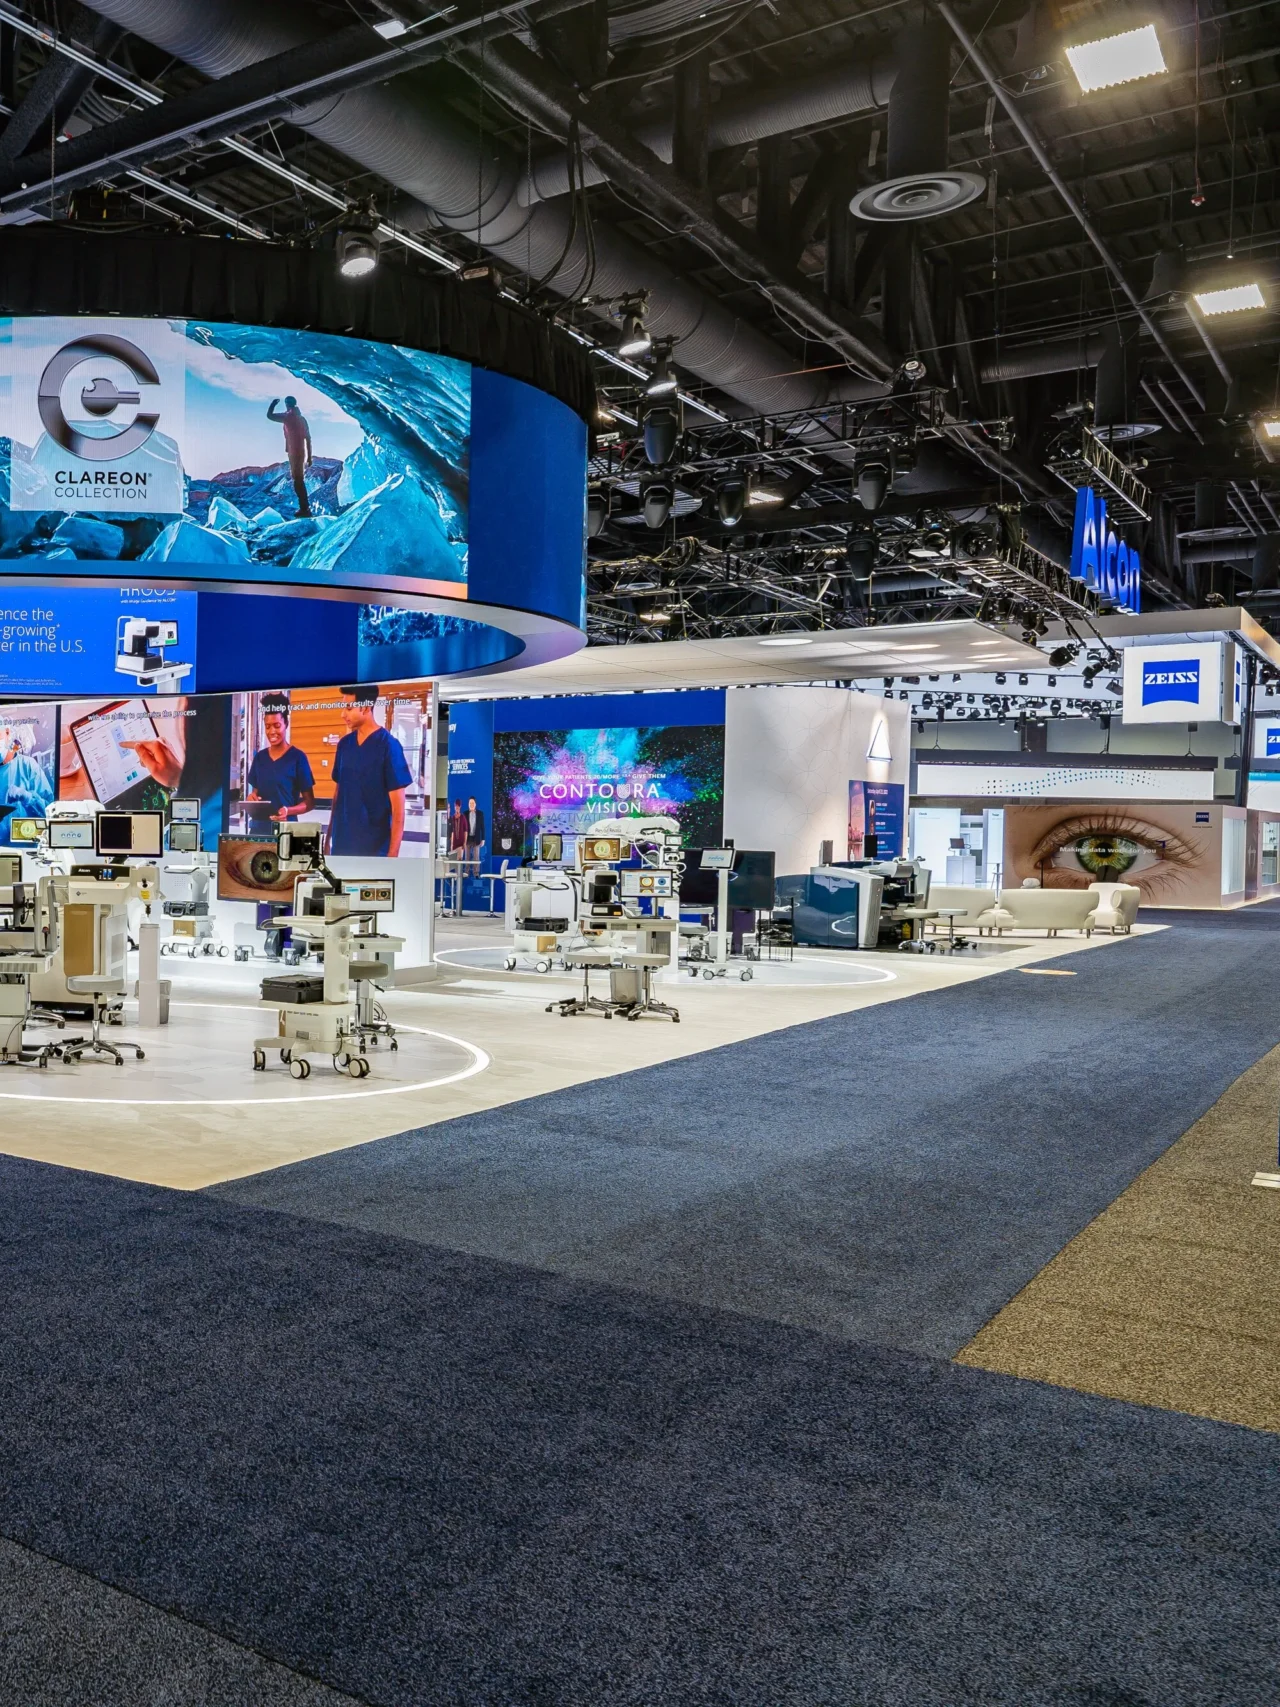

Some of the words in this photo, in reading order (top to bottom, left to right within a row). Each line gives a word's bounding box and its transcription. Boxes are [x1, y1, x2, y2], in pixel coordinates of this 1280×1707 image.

[55, 487, 147, 499] COLLECTION
[1072, 486, 1140, 615] Alcon
[32, 608, 54, 621] the
[19, 641, 31, 652] in
[35, 640, 56, 652] the
[61, 639, 86, 653] U.S.
[1144, 671, 1198, 685] ZEISS
[272, 704, 287, 713] help
[288, 703, 304, 711] track
[306, 702, 319, 710] and
[320, 699, 349, 709] monitor
[350, 699, 374, 708] results
[173, 708, 197, 718] process
[586, 801, 641, 814] VISION
[1059, 846, 1086, 855] Making
